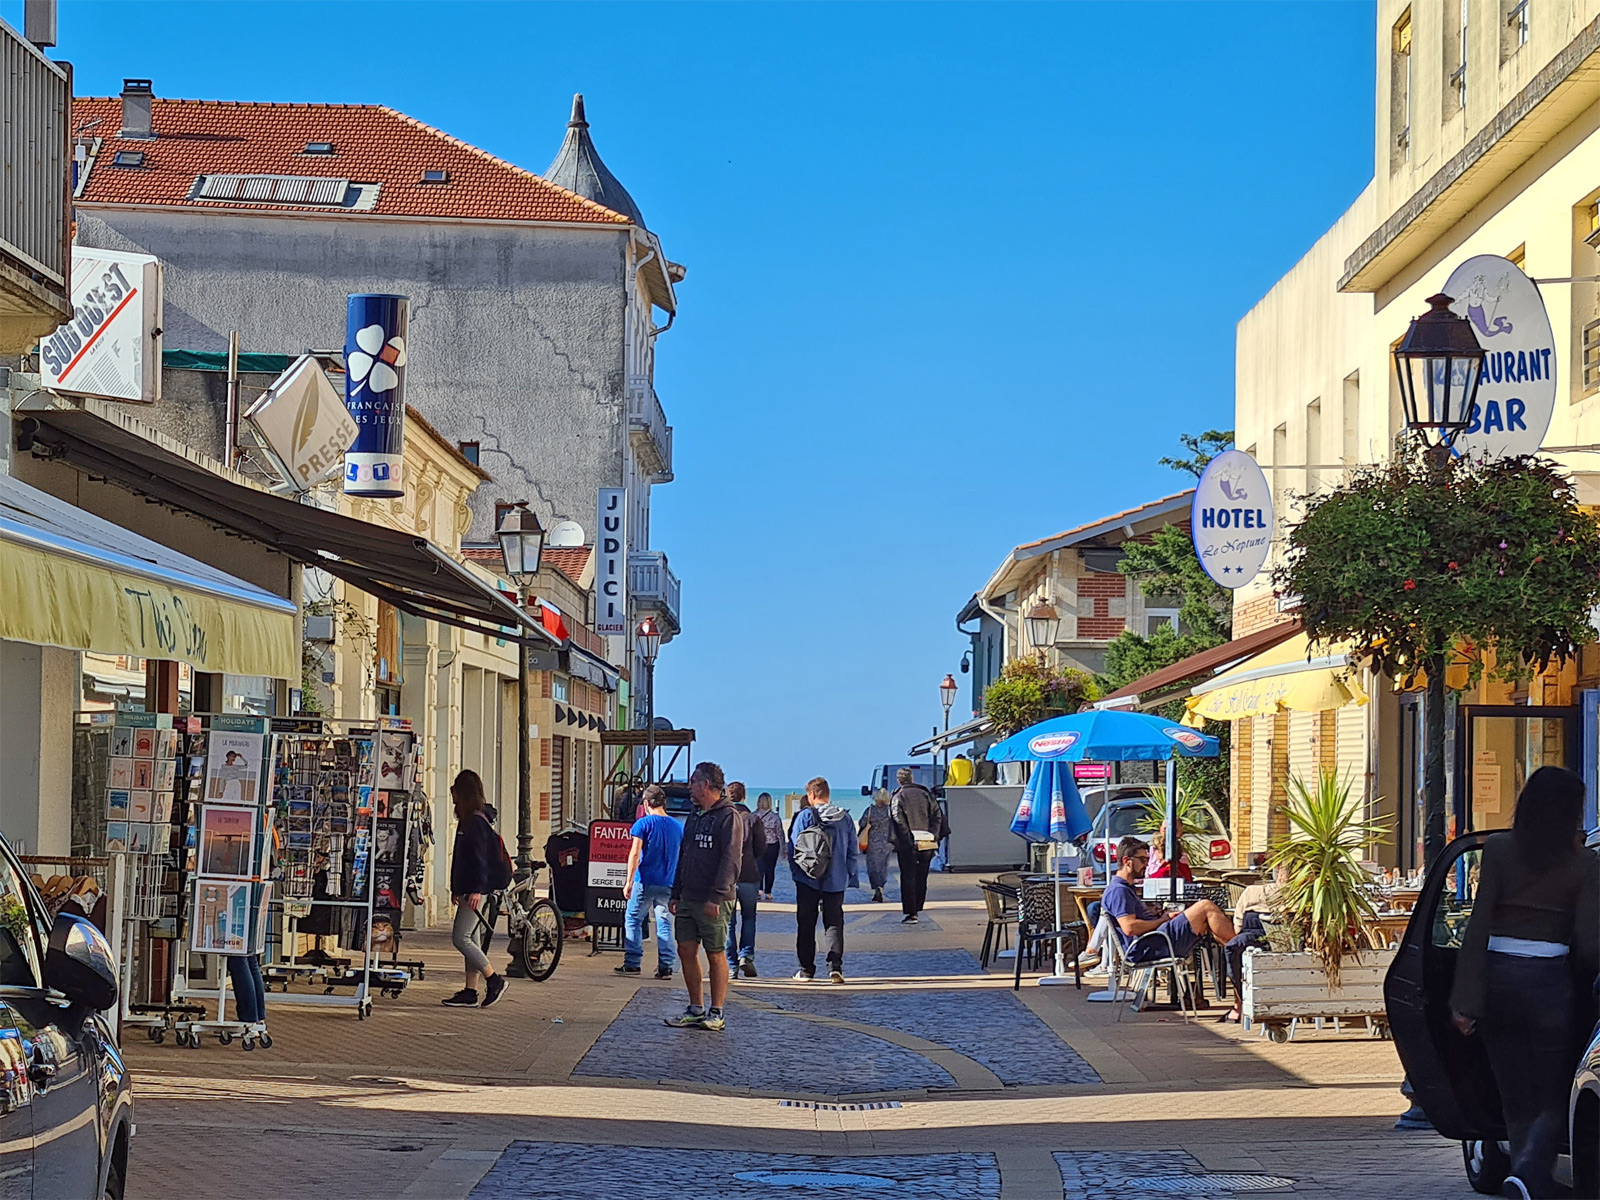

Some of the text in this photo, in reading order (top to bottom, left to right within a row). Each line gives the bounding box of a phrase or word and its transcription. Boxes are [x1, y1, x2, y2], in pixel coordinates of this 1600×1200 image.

[42, 322, 82, 376] SUD
[355, 415, 401, 425] ES JEUX
[1464, 397, 1527, 435] BAR
[296, 418, 355, 483] PRESSE
[346, 462, 402, 482] LOTO
[1201, 507, 1267, 529] HOTEL
[603, 495, 620, 618] JUDICI
[1201, 536, 1267, 559] Le Neptune
[597, 623, 624, 632] GLACIER
[123, 713, 150, 721] HOLIDAYS
[220, 717, 255, 726] HOLIDAYS
[592, 878, 614, 886] SERGE
[597, 897, 627, 909] KAPOR
